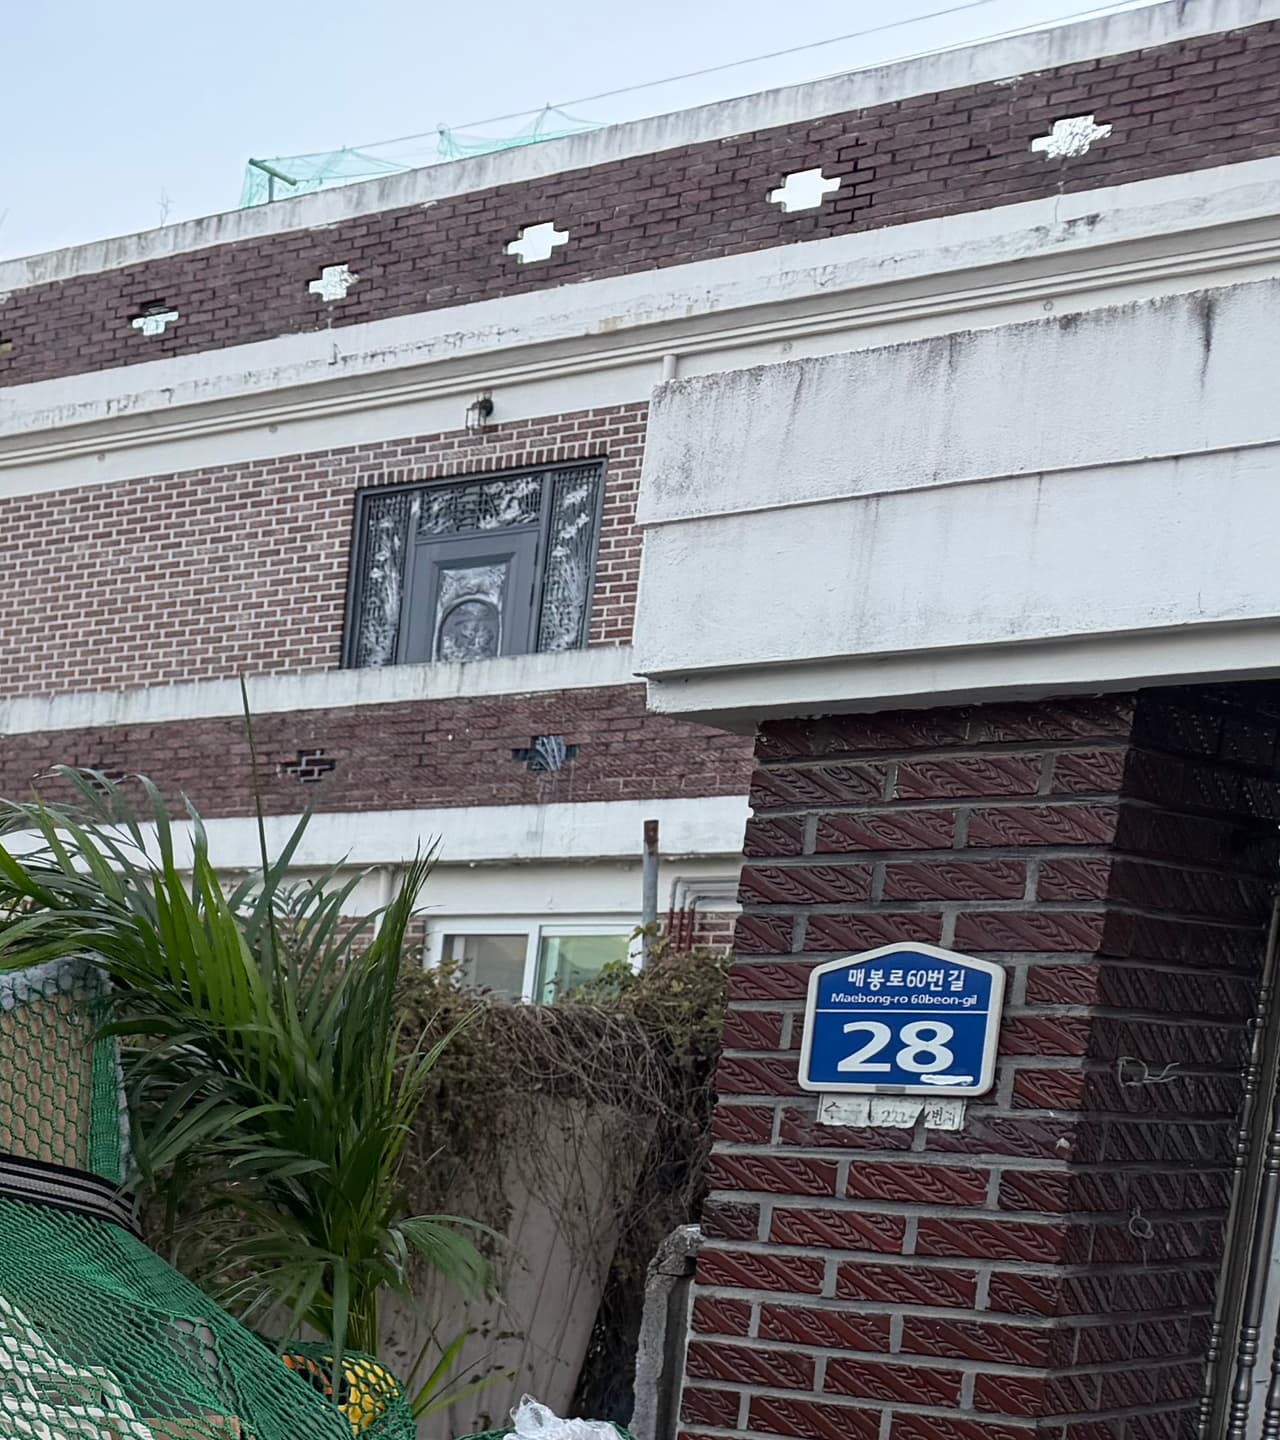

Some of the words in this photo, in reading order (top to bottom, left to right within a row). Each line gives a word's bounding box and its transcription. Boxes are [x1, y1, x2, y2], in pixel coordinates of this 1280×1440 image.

[848, 968, 966, 991] 매봉로60번길
[831, 992, 909, 1006] Maebong-ro
[911, 994, 978, 1008] 60beon-gil
[837, 1020, 954, 1073] 28
